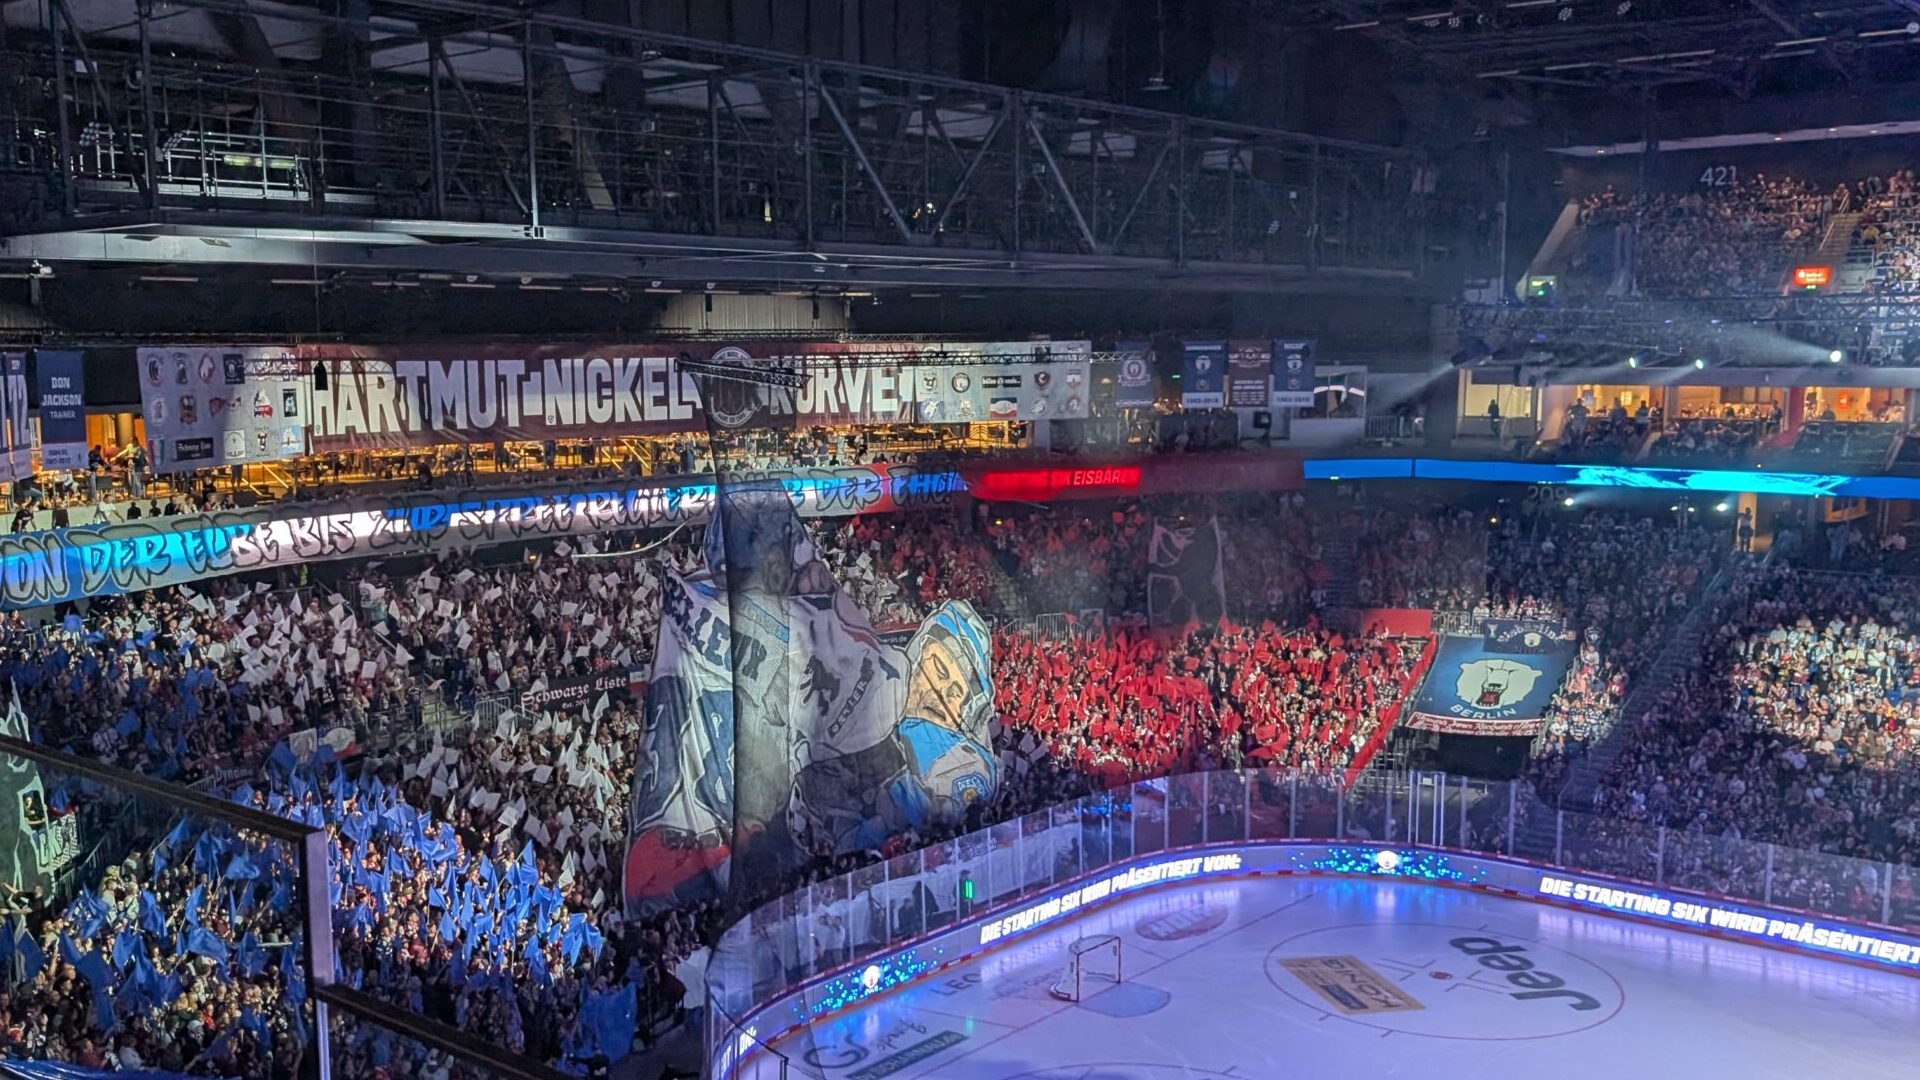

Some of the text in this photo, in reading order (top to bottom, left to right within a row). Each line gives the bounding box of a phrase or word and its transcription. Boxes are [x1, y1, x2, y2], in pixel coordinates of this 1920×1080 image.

[1700, 165, 1739, 186] 421
[51, 377, 70, 388] DON
[42, 394, 81, 406] JACKSON
[49, 411, 76, 419] TRAINER
[66, 523, 171, 593] DER
[807, 467, 881, 511] DER
[521, 676, 627, 718] Schwarze Liste
[1450, 704, 1517, 719] BERLIN
[980, 921, 1002, 945] DIE
[1060, 886, 1081, 913] SIX
[1540, 877, 1920, 965] DIE STARTING SIX WIRD PRÄSENTIERT
[1448, 937, 1601, 1011] Jeep
